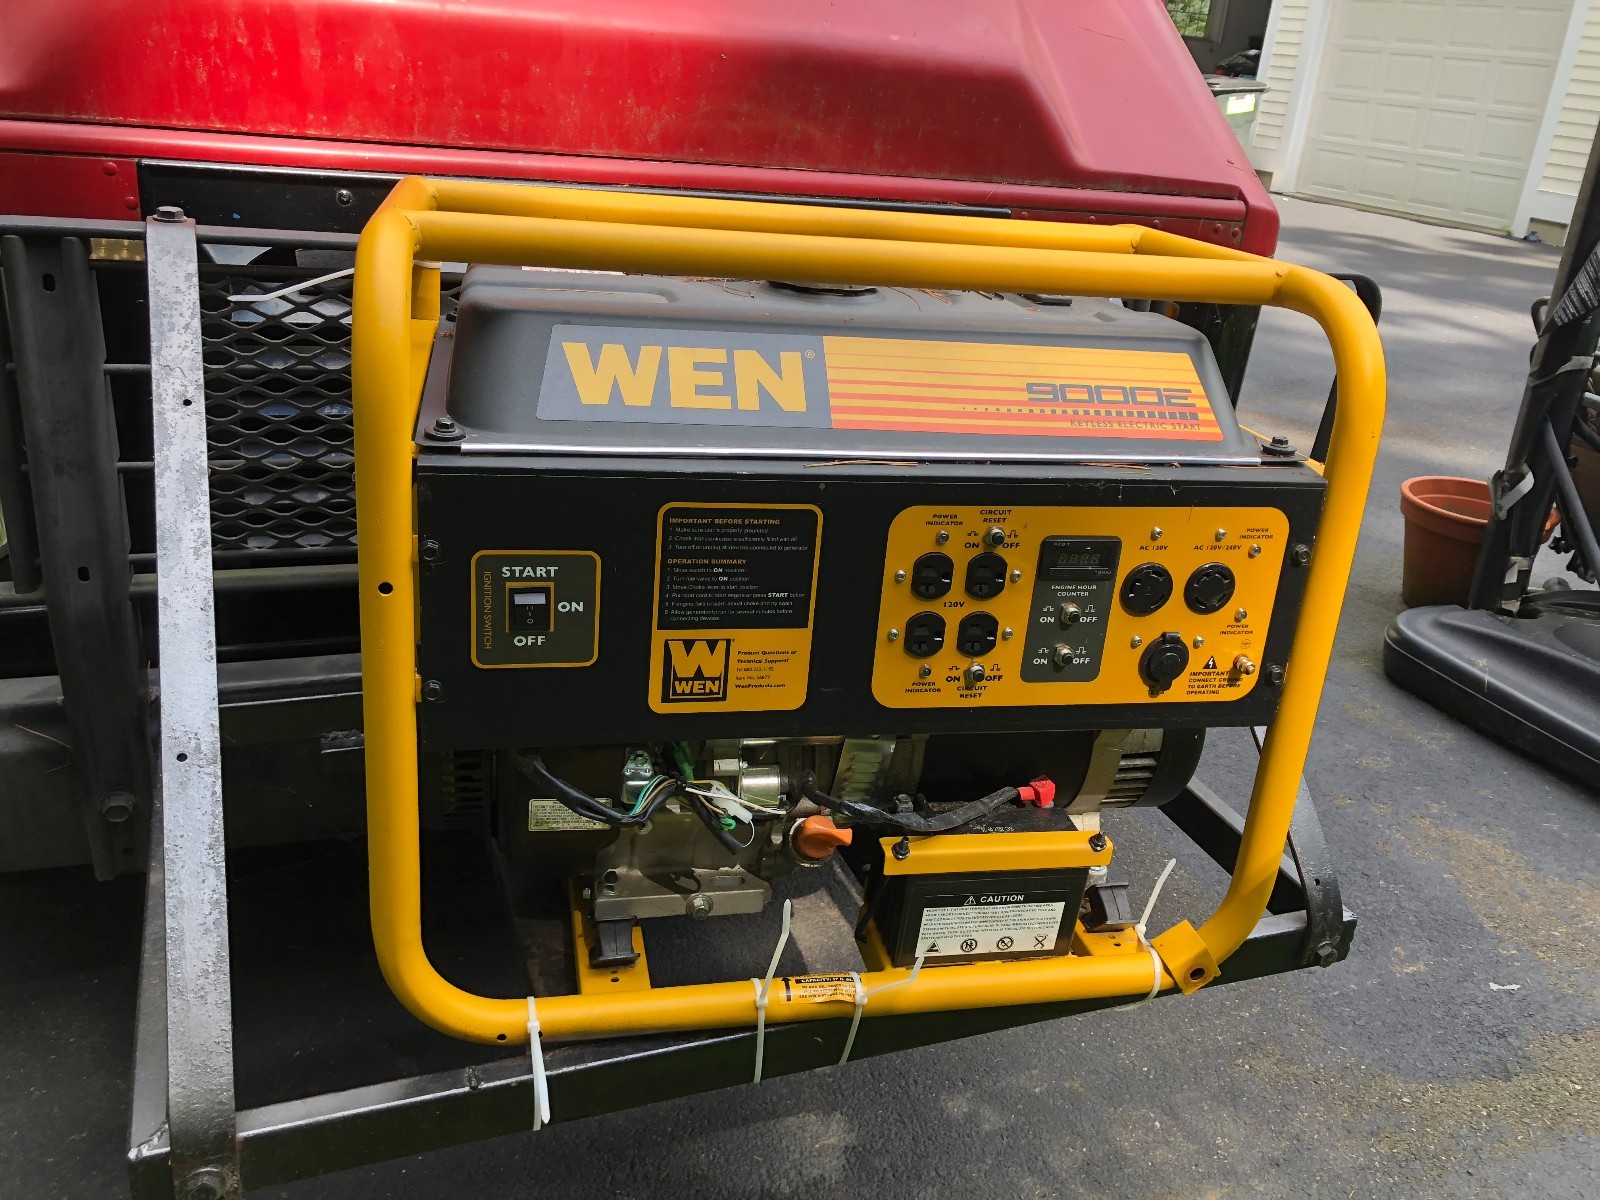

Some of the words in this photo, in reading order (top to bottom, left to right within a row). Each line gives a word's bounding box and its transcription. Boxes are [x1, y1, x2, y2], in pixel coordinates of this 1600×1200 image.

[562, 342, 807, 412] WEN
[1026, 382, 1196, 407] 9000E
[1070, 419, 1113, 428] KEYLESS
[1118, 420, 1167, 430] ELECTRIC
[1171, 422, 1202, 431] START
[501, 566, 559, 578] START
[483, 571, 492, 613] IGNITION
[557, 601, 584, 612] ON
[483, 614, 492, 650] SWITCH
[513, 635, 546, 647] OFF
[674, 680, 720, 694] WEN
[980, 894, 1025, 903] CAUTION
